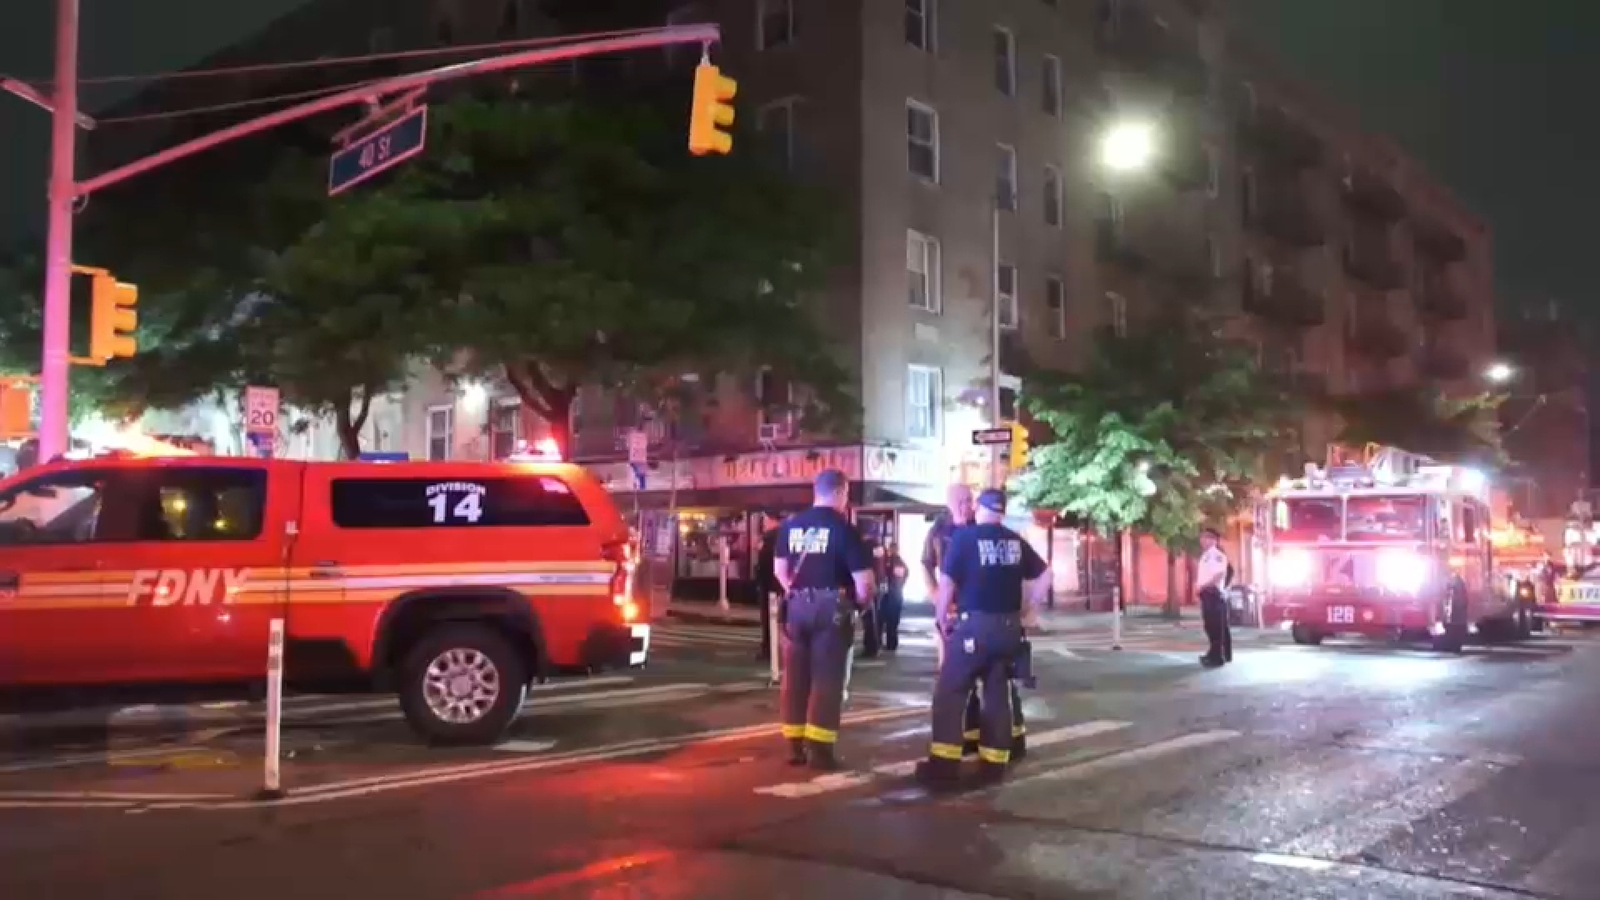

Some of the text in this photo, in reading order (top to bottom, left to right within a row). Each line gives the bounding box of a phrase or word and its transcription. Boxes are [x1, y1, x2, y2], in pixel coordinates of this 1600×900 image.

[251, 409, 274, 426] 20
[426, 482, 486, 496] DIVISION
[428, 493, 482, 523] 14
[126, 567, 252, 606] FDNY
